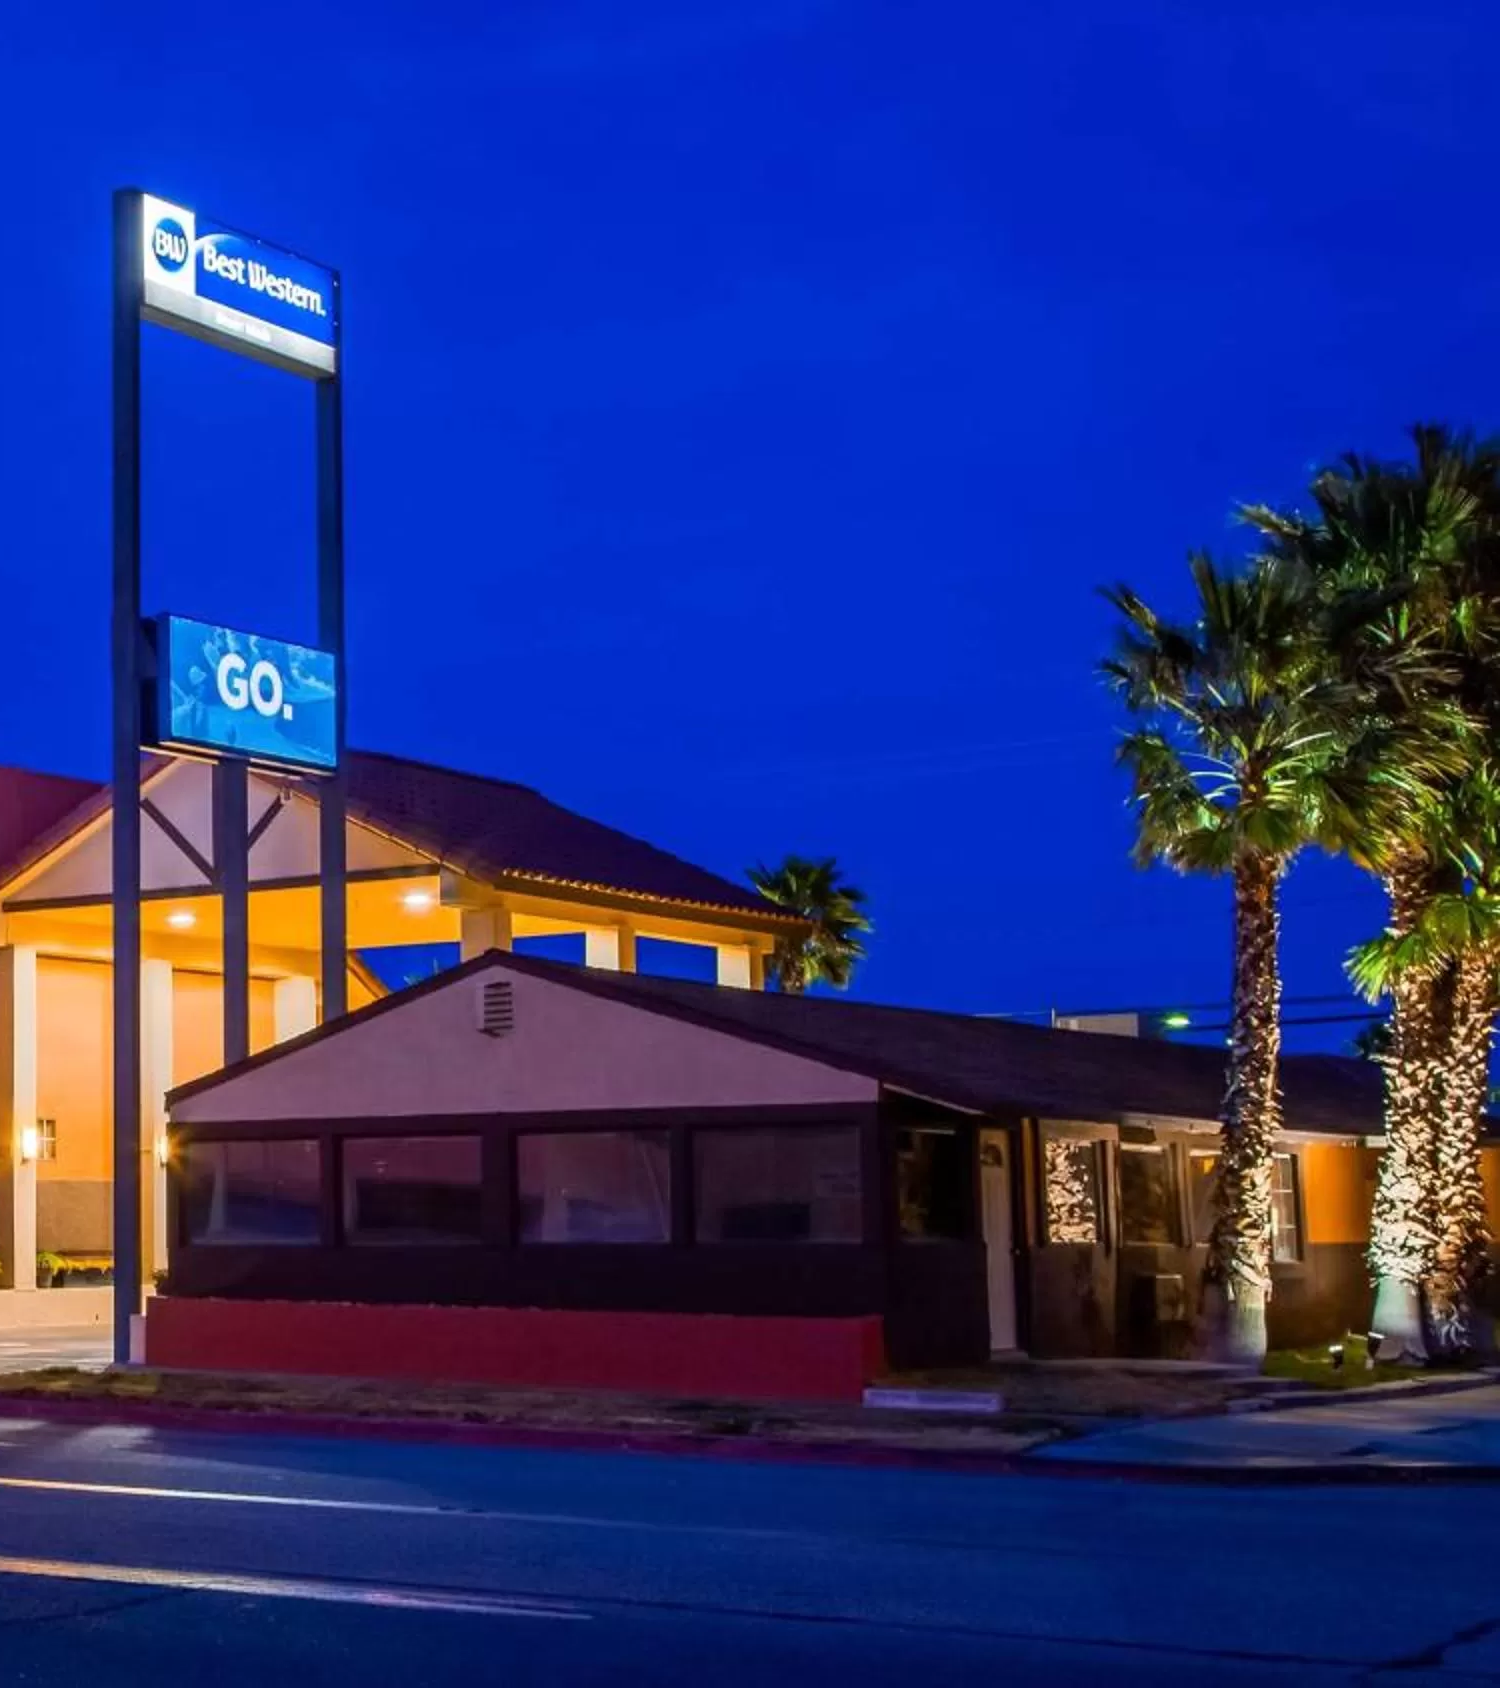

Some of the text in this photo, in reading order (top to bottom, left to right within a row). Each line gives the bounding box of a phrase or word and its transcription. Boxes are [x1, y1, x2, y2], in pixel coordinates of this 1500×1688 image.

[155, 228, 185, 263] BW
[203, 244, 246, 284] Best
[217, 652, 293, 721] GO.
